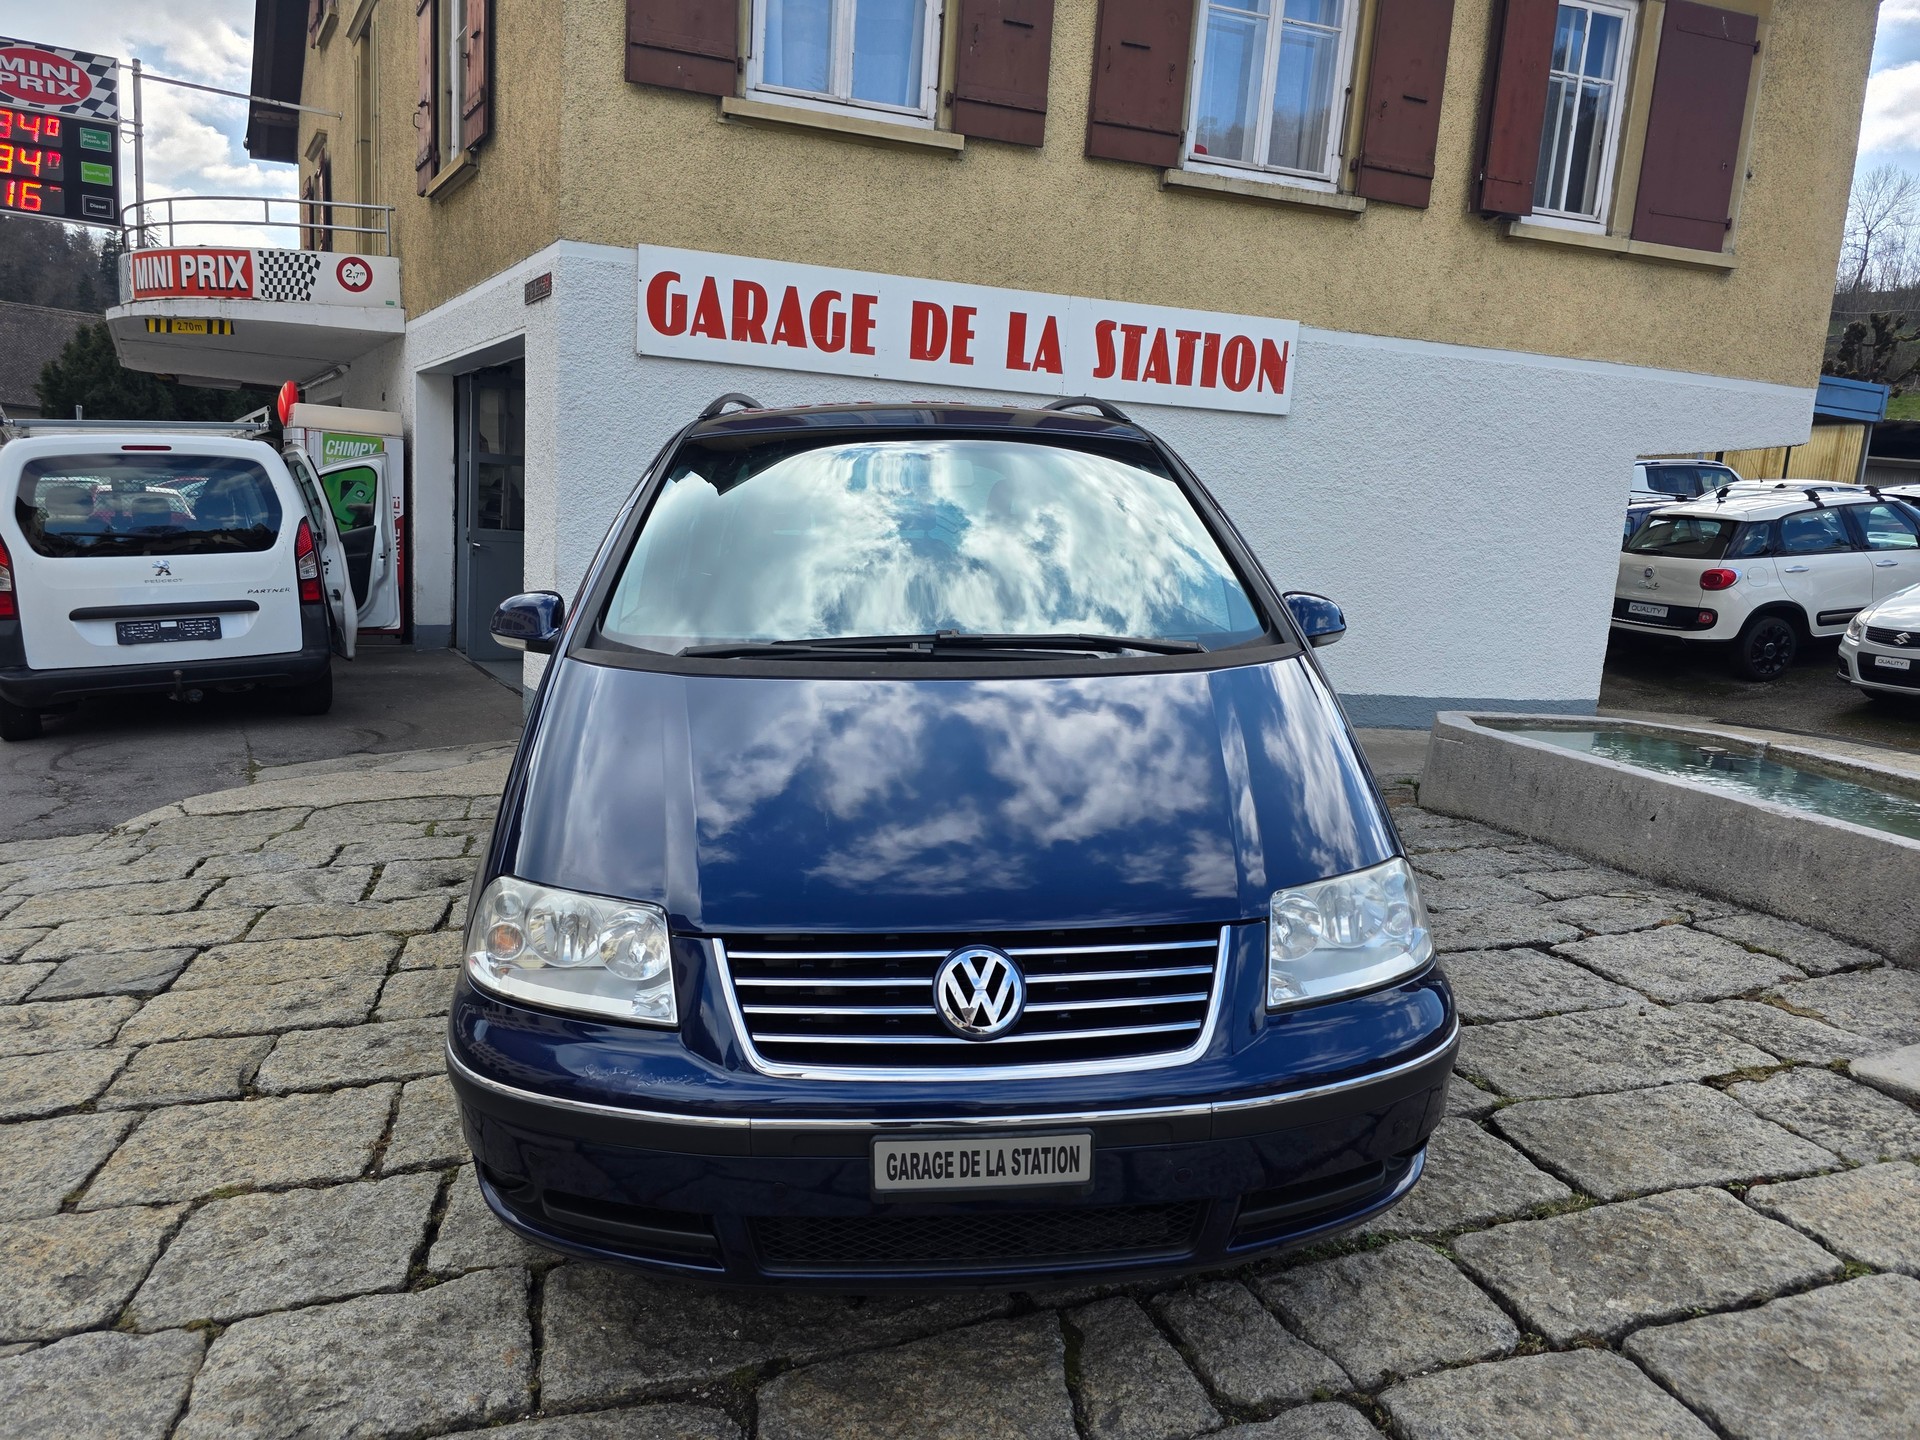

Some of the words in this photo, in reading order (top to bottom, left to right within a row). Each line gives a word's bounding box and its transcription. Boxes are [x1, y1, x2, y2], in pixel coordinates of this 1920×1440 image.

[135, 255, 173, 290] MINI
[181, 254, 249, 291] PRIX
[177, 321, 203, 331] 2.70m
[646, 271, 878, 356] GARAGE
[910, 300, 977, 365] DE
[1006, 311, 1063, 374] LA
[1093, 319, 1290, 395] STATION
[326, 440, 377, 456] CHIMPY
[886, 1151, 954, 1181] GARAGE
[959, 1150, 981, 1178] DE
[986, 1149, 1007, 1177] LA
[1011, 1145, 1080, 1176] STATION
